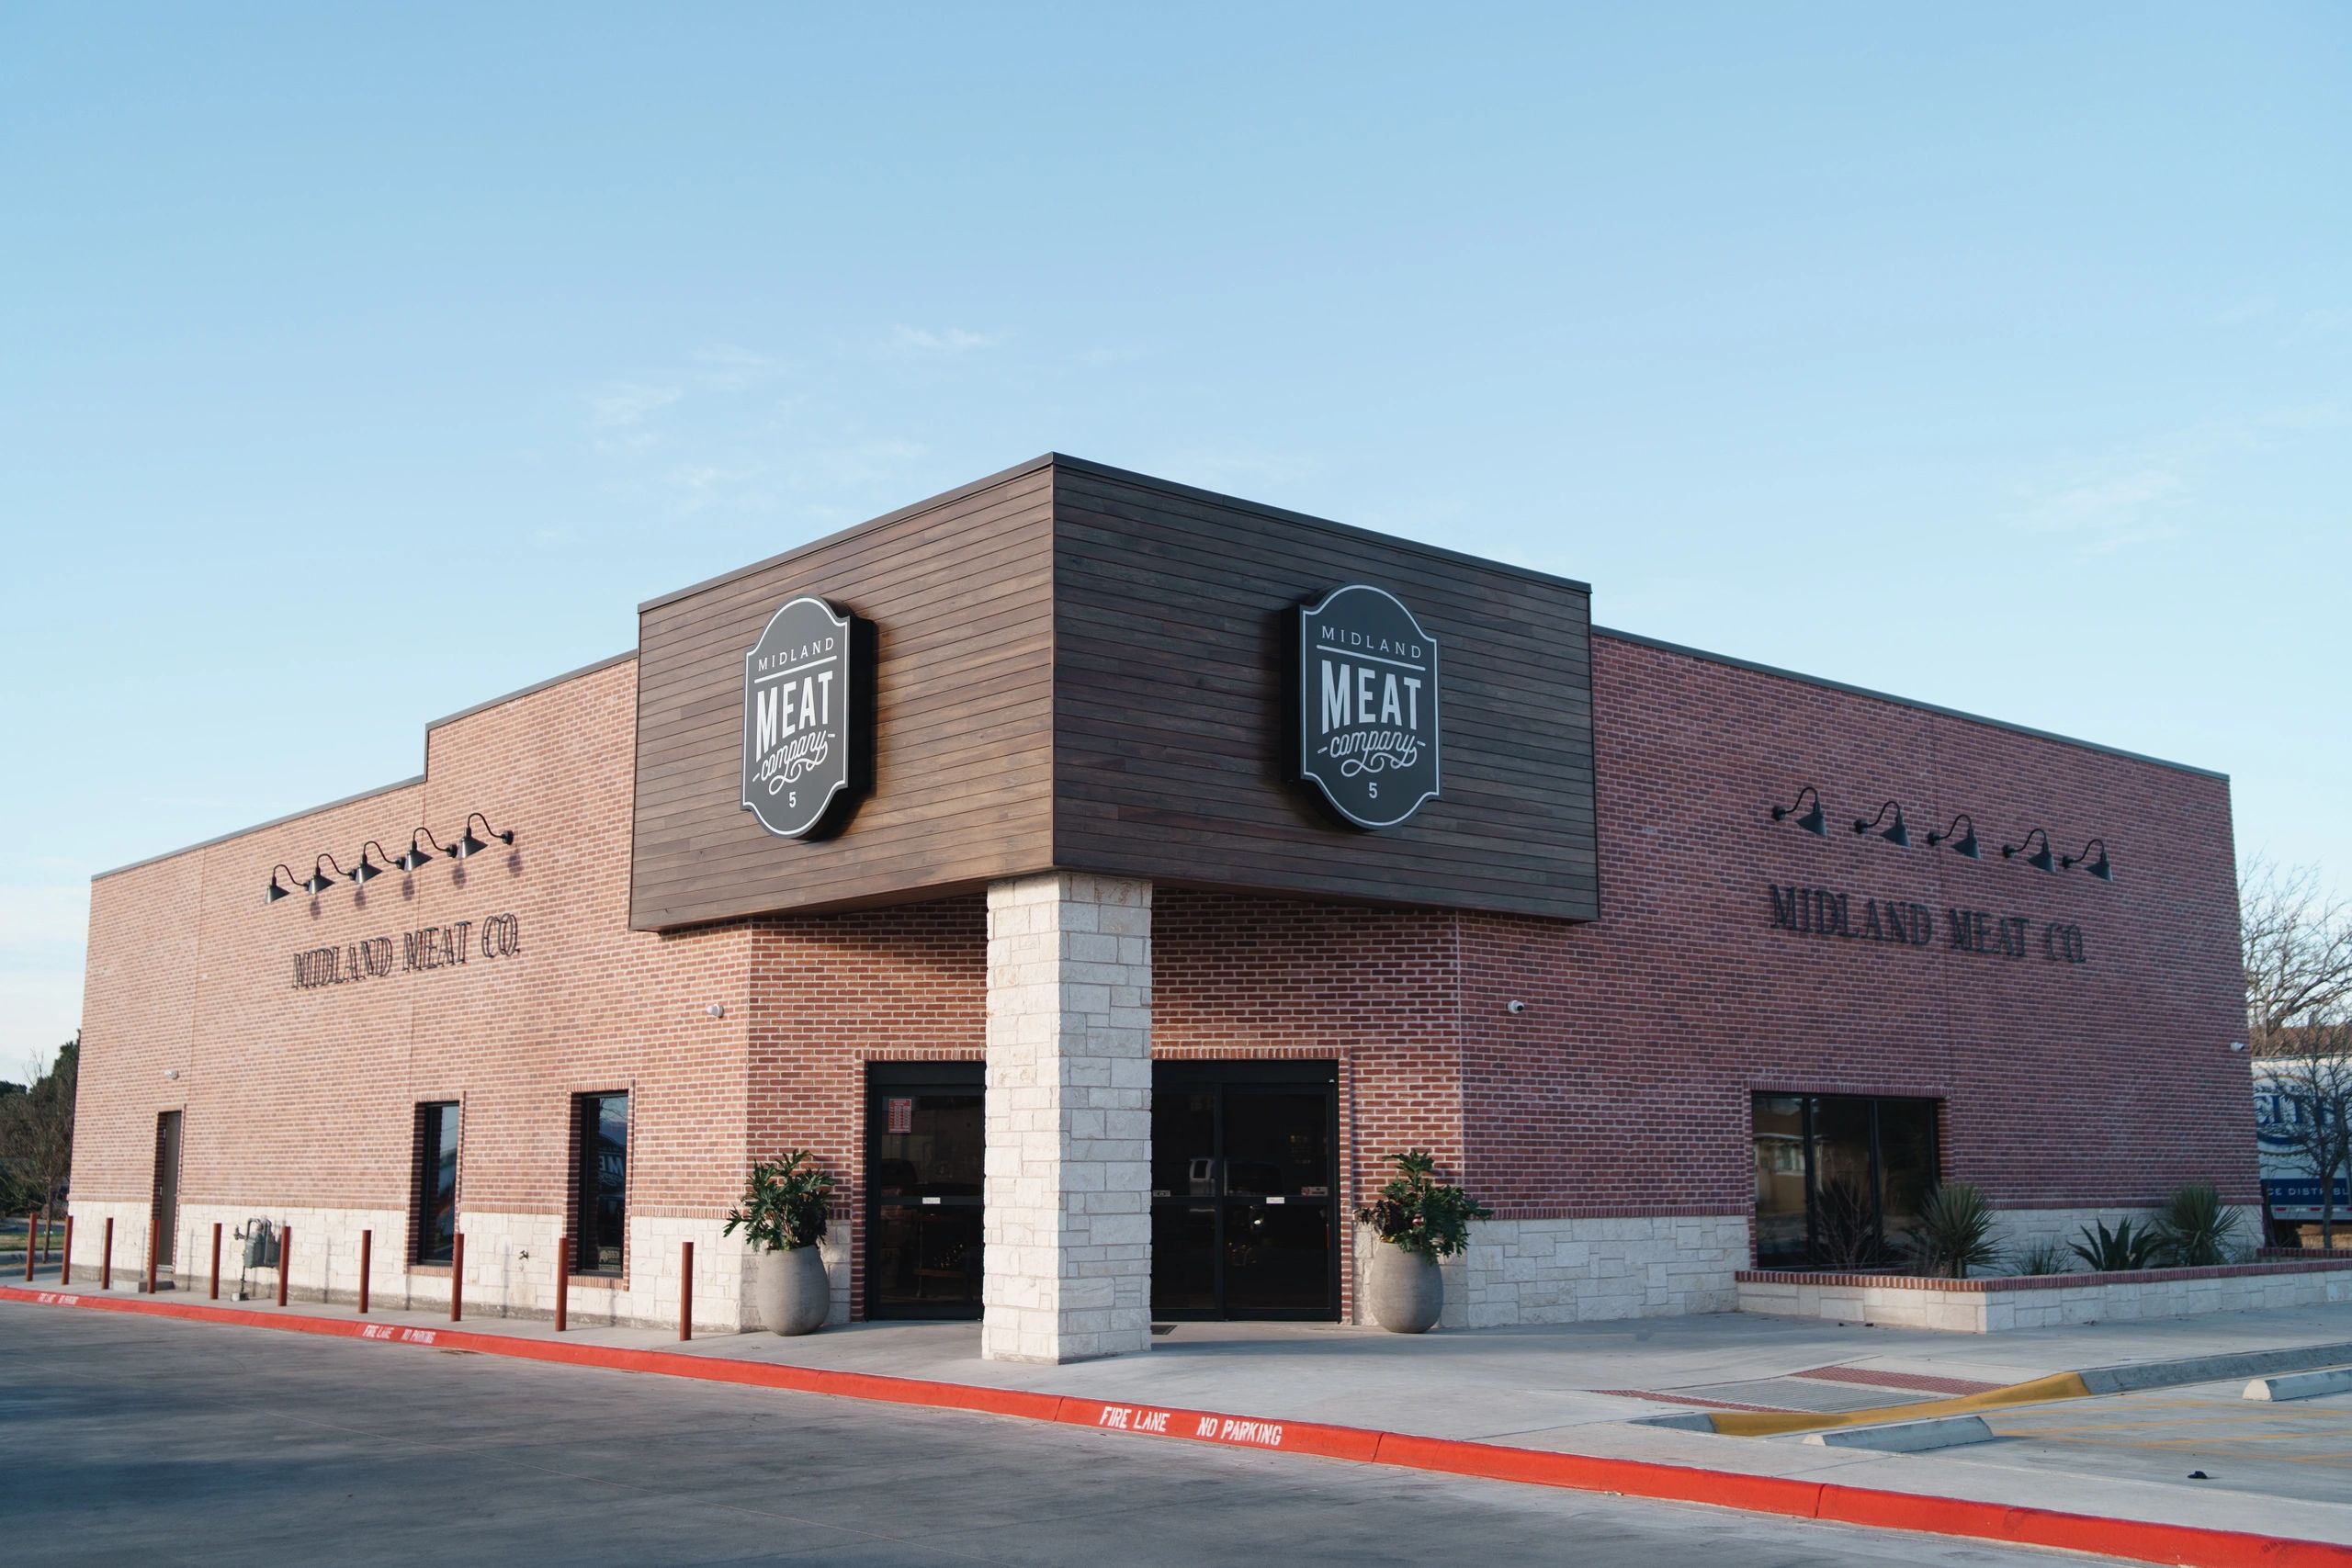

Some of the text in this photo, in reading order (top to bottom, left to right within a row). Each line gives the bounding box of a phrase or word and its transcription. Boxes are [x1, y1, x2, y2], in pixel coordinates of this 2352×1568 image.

[758, 637, 835, 671] MIDLAND
[1321, 626, 1421, 659] MIDLAND
[755, 670, 833, 762] MEAT
[1321, 660, 1422, 735] MEAT
[761, 729, 829, 795] company
[1329, 730, 1419, 777] company
[788, 791, 797, 807] 5
[1369, 783, 1377, 798] 5
[1769, 884, 1933, 946] MIDLAND
[1948, 908, 2030, 958] MEAT
[291, 936, 393, 989] MIDLAND
[401, 919, 472, 973] MEAT
[1099, 1405, 1170, 1433] FIRE LANE
[1196, 1416, 1283, 1447] NO PARKING
